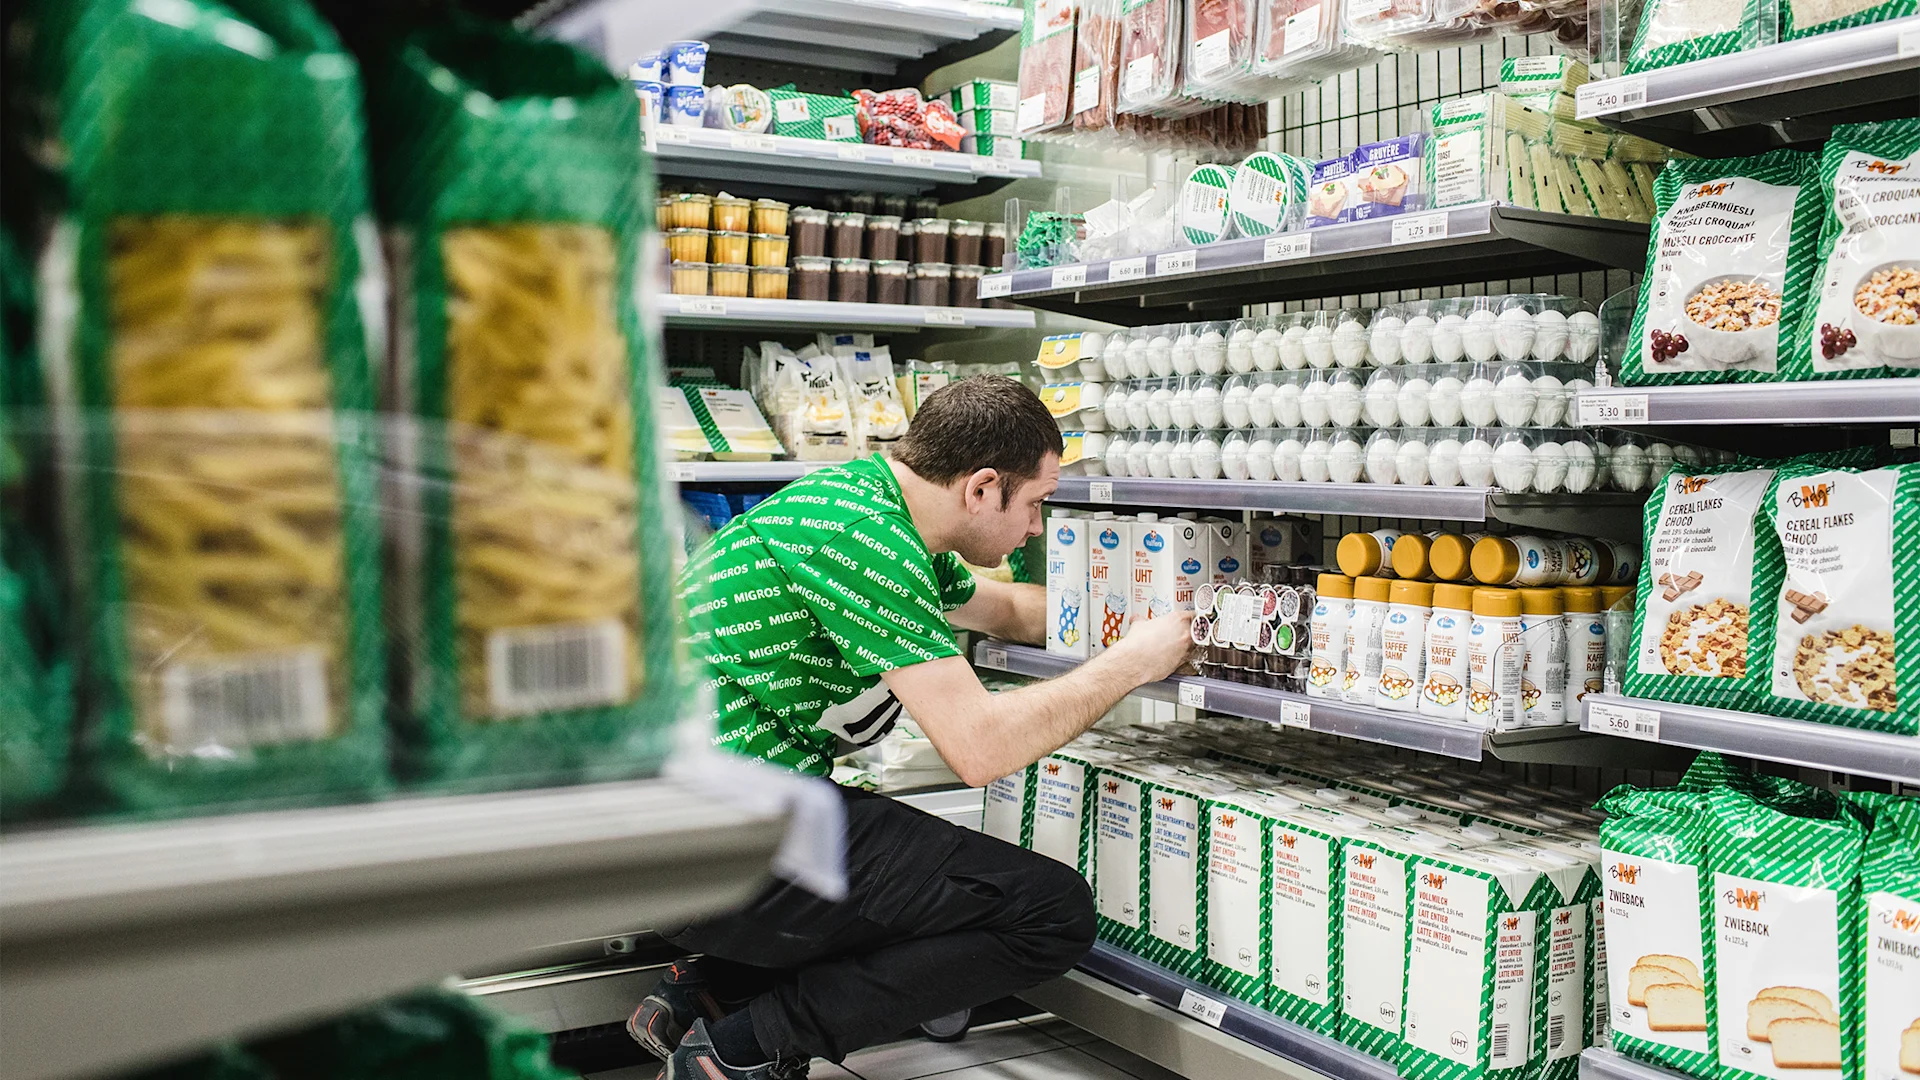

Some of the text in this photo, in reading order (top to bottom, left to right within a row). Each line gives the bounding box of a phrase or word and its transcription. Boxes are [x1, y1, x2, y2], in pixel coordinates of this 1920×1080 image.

[1597, 95, 1617, 106] 4.40
[1437, 151, 1451, 161] TOAST
[1873, 188, 1920, 203] CROQUAN
[1677, 201, 1754, 216] KNABBERMÜESLI
[1704, 216, 1757, 230] CROQUANT
[1868, 212, 1920, 228] CROCCANT
[1408, 226, 1424, 236] 1.75
[1698, 232, 1757, 246] CROCCANTE
[1277, 244, 1291, 254] 2.50
[1662, 249, 1682, 258] Nature
[1167, 260, 1180, 269] 1.85
[1120, 267, 1131, 276] 6.60
[1599, 408, 1618, 416] 3.30
[786, 494, 828, 506] MIGROS
[834, 498, 885, 525] MIGROS
[1669, 498, 1724, 516] CEREAL FLAKES
[800, 517, 846, 532] MIGROS
[1665, 516, 1693, 527] CHOCO
[1786, 513, 1854, 532] CEREAL FLAKES
[1683, 527, 1712, 536] Schokolade
[852, 530, 898, 560] MIGROS
[890, 524, 928, 561] MIGROS
[1684, 536, 1690, 544] de
[1691, 536, 1714, 544] chocolat
[1784, 532, 1818, 545] CHOCO
[768, 537, 814, 556] MIGROS
[1810, 545, 1840, 555] Schokolade
[1136, 550, 1146, 558] Milch
[1818, 555, 1841, 564] chocolat
[1050, 561, 1065, 574] UHT
[1654, 558, 1664, 567] 600
[708, 564, 748, 584] MIGROS
[903, 558, 938, 596] MIGROS
[1092, 566, 1108, 579] UHT
[1136, 569, 1152, 583] UHT
[863, 567, 910, 598] MIGROS
[734, 586, 782, 604] MIGROS
[1176, 590, 1194, 602] UHT
[876, 605, 925, 634] MIGROS
[714, 620, 763, 638] MIGROS
[748, 640, 798, 660] MIGROS
[895, 636, 940, 662] MIGROS
[1385, 641, 1408, 653] KAFFEE
[1431, 646, 1456, 658] KAFFEE
[788, 652, 833, 668] MIGROS
[1385, 651, 1402, 661] RAHM
[1432, 656, 1451, 666] RAHM
[1587, 653, 1604, 662] KAFF
[768, 676, 802, 691] MIGROS
[808, 676, 853, 694] MIGROS
[1190, 693, 1202, 702] 1.05
[1294, 712, 1308, 722] 1.10
[1610, 718, 1629, 728] 5.60
[1214, 830, 1236, 842] VOLLMILCH
[1212, 844, 1222, 853] LAIT
[1222, 848, 1236, 858] ENTIER
[1276, 850, 1299, 863] VOLLMILCH
[1211, 860, 1222, 869] LATTE
[1223, 863, 1237, 874] INTERO
[1276, 866, 1286, 874] LAIT
[1286, 868, 1300, 880] ENTIER
[1350, 871, 1376, 884] VOLLMILCH
[1276, 882, 1288, 891] LATTE
[1288, 884, 1303, 896] INTERO
[1349, 888, 1360, 896] LAIT
[1360, 890, 1376, 901] ENTIER
[1419, 892, 1448, 906] VOLLMILCH
[1609, 889, 1645, 908] ZWIEBACK
[1722, 890, 1766, 910] Budget
[1348, 904, 1360, 914] LATTE
[1361, 906, 1378, 920] INTERO
[1418, 908, 1448, 924] LAIT ENTIER
[1724, 916, 1770, 936] ZWIEBACK
[1178, 929, 1190, 938] UHT
[1416, 926, 1452, 944] LATTE INTERO
[1878, 936, 1920, 959] ZWIEBAC
[1238, 952, 1252, 962] UHT
[1498, 970, 1510, 978] LATTE
[1306, 979, 1320, 990] UHT
[1192, 1002, 1206, 1013] 2.00
[1380, 1007, 1396, 1018] UHT
[1450, 1038, 1468, 1048] UHT
